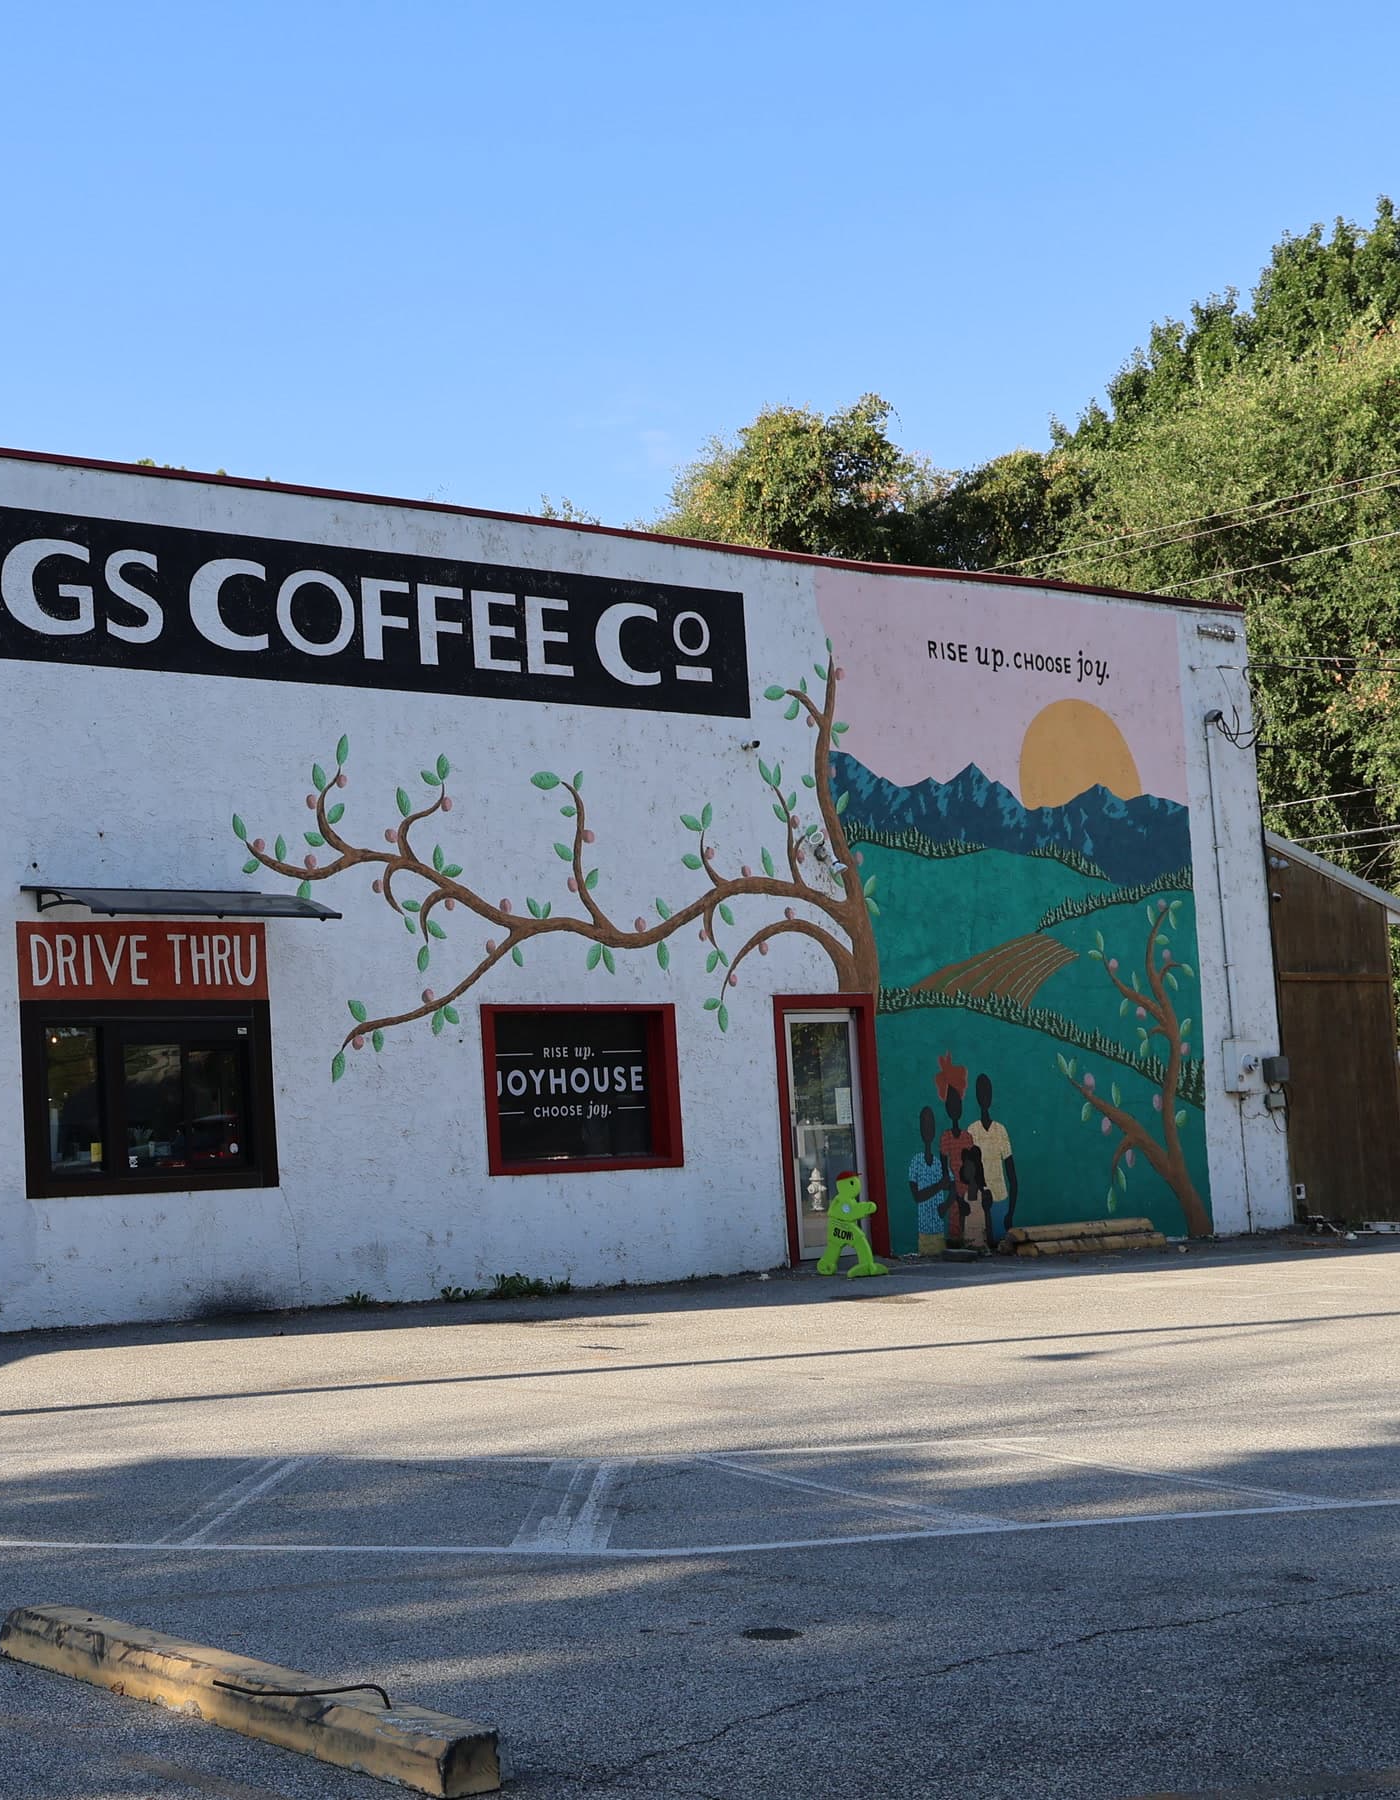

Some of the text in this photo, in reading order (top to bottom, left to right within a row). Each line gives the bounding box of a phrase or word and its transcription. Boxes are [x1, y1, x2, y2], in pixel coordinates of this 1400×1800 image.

[189, 558, 575, 677] COFFEE
[927, 640, 1110, 686] RISE up. CHOOSE joy.
[29, 934, 257, 986] DRIVE THRU
[543, 1046, 595, 1060] RISE up.
[496, 1066, 644, 1096] JOYHOUSE
[533, 1100, 612, 1119] CHOOSE joy.
